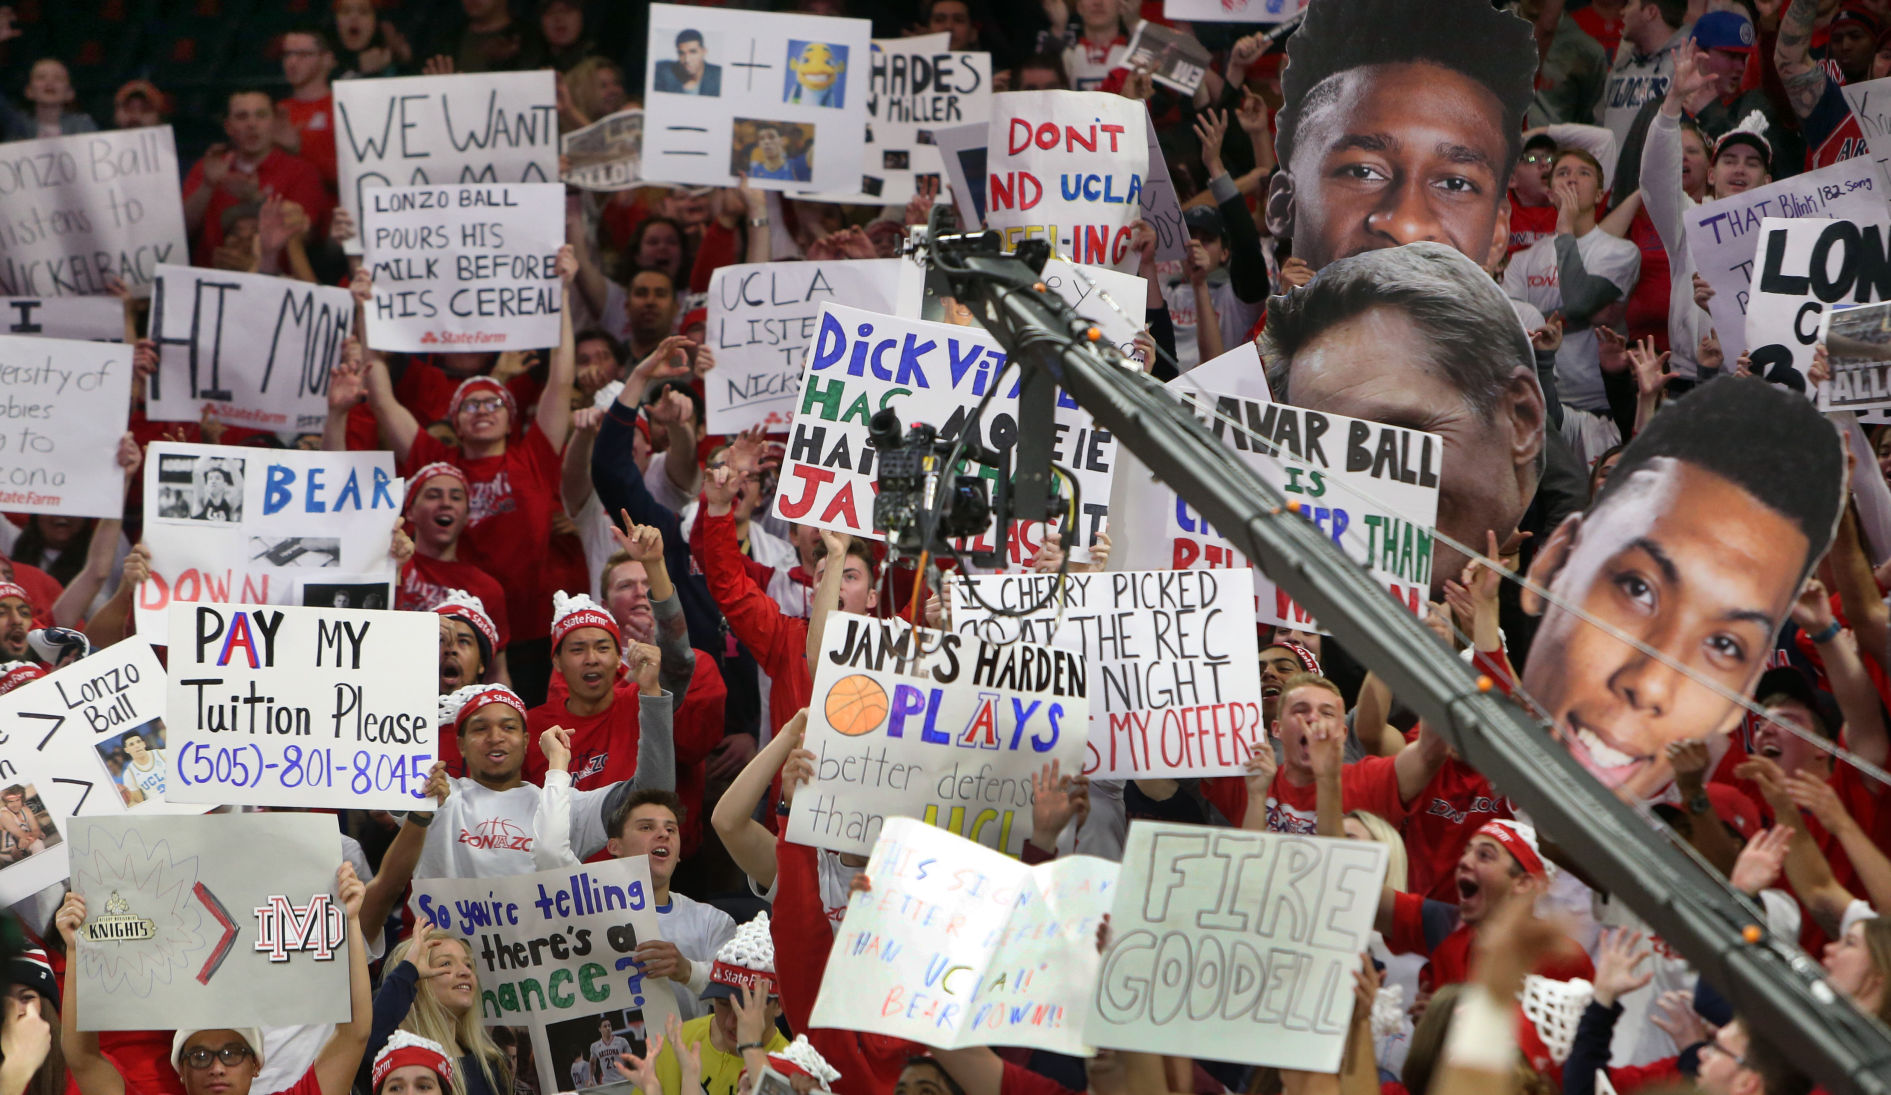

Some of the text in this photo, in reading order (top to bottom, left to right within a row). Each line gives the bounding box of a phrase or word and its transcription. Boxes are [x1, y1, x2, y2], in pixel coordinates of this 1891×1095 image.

[338, 89, 556, 162] WE WANT
[89, 132, 161, 183] Ball
[108, 189, 145, 228] to
[375, 188, 518, 213] LONZO BALL
[985, 171, 1043, 212] ND
[1061, 174, 1142, 206] UCLA
[376, 223, 504, 250] POURS HIS
[1700, 200, 1772, 245] THAT
[371, 255, 559, 283] MILK BEFORE
[721, 268, 836, 312] UCLA
[10, 301, 42, 333] I
[376, 287, 561, 320] HIS CEREAL
[151, 276, 241, 402] HI
[76, 359, 117, 392] of
[19, 427, 55, 454] to
[1346, 420, 1438, 489] BALL
[263, 465, 397, 516] BEAR
[1284, 467, 1327, 498] IS
[1364, 514, 1434, 585] THAN
[140, 568, 270, 611] DOWN
[1000, 574, 1092, 610] CHERRY
[1113, 570, 1218, 609] PICKED
[196, 606, 371, 670] PAY MY
[829, 619, 1088, 698] JAMES HARDEN
[1068, 612, 1140, 661] THE
[1154, 608, 1229, 660] REC
[54, 662, 141, 711] Lonzo
[1102, 660, 1232, 713] NIGHT
[83, 691, 139, 734] Ball
[180, 679, 429, 745] Tuition Please
[886, 684, 1065, 752] PLAYS
[1109, 709, 1151, 772] MY
[177, 740, 433, 798] (505)-801-8045
[818, 740, 923, 792] better
[418, 872, 646, 936] So you're telling
[1142, 831, 1381, 952] FIRE
[89, 920, 149, 939] KNIGHTS
[481, 922, 638, 972] there's a
[844, 931, 903, 963] THAN
[1096, 929, 1345, 1035] GOODELL
[881, 984, 961, 1030] BEAR
